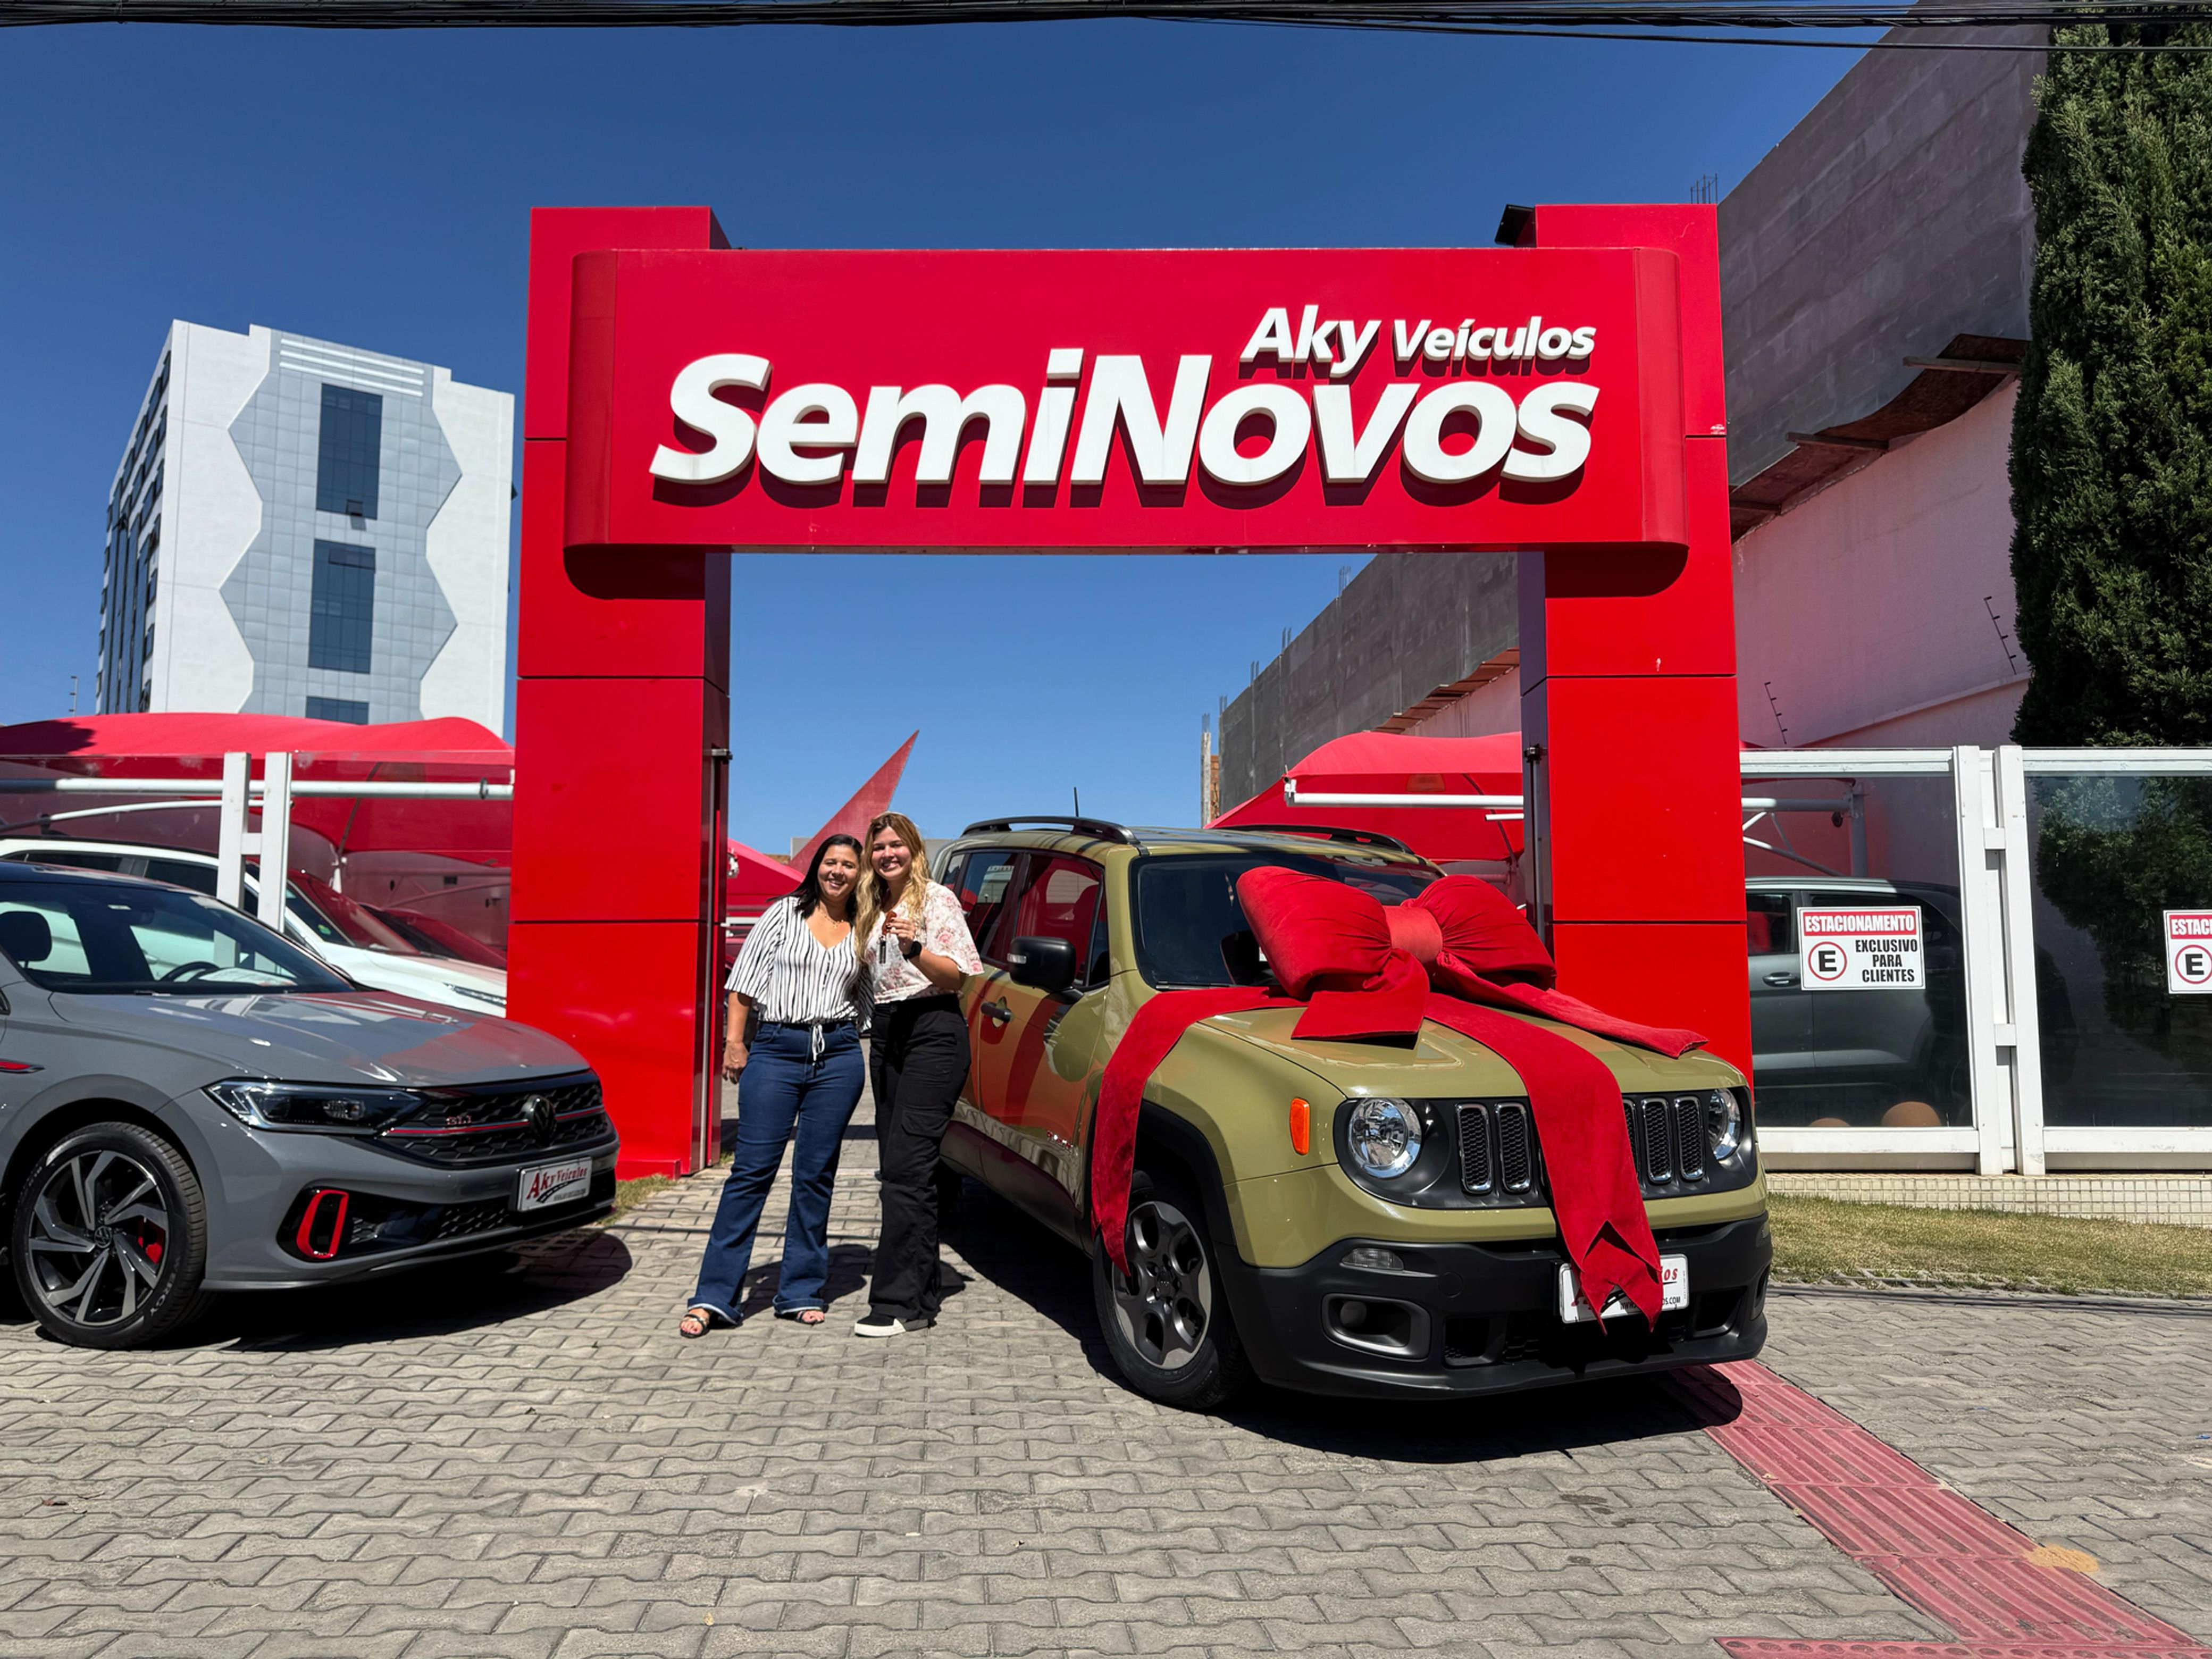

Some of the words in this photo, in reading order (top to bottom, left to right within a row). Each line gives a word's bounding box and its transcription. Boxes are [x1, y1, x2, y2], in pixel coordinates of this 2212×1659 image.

[1240, 305, 1381, 378] Aky
[1393, 316, 1597, 361] Veículos
[649, 348, 1600, 483] SemiNovos
[1805, 915, 1914, 932] ESTACIONAMENTO
[1855, 939, 1917, 952] EXCLUSIVO
[1818, 950, 1837, 972] E
[1872, 954, 1902, 967] PARA
[2185, 953, 2204, 975] E
[1862, 969, 1915, 983] CLIENTES
[526, 1170, 556, 1200] Aky
